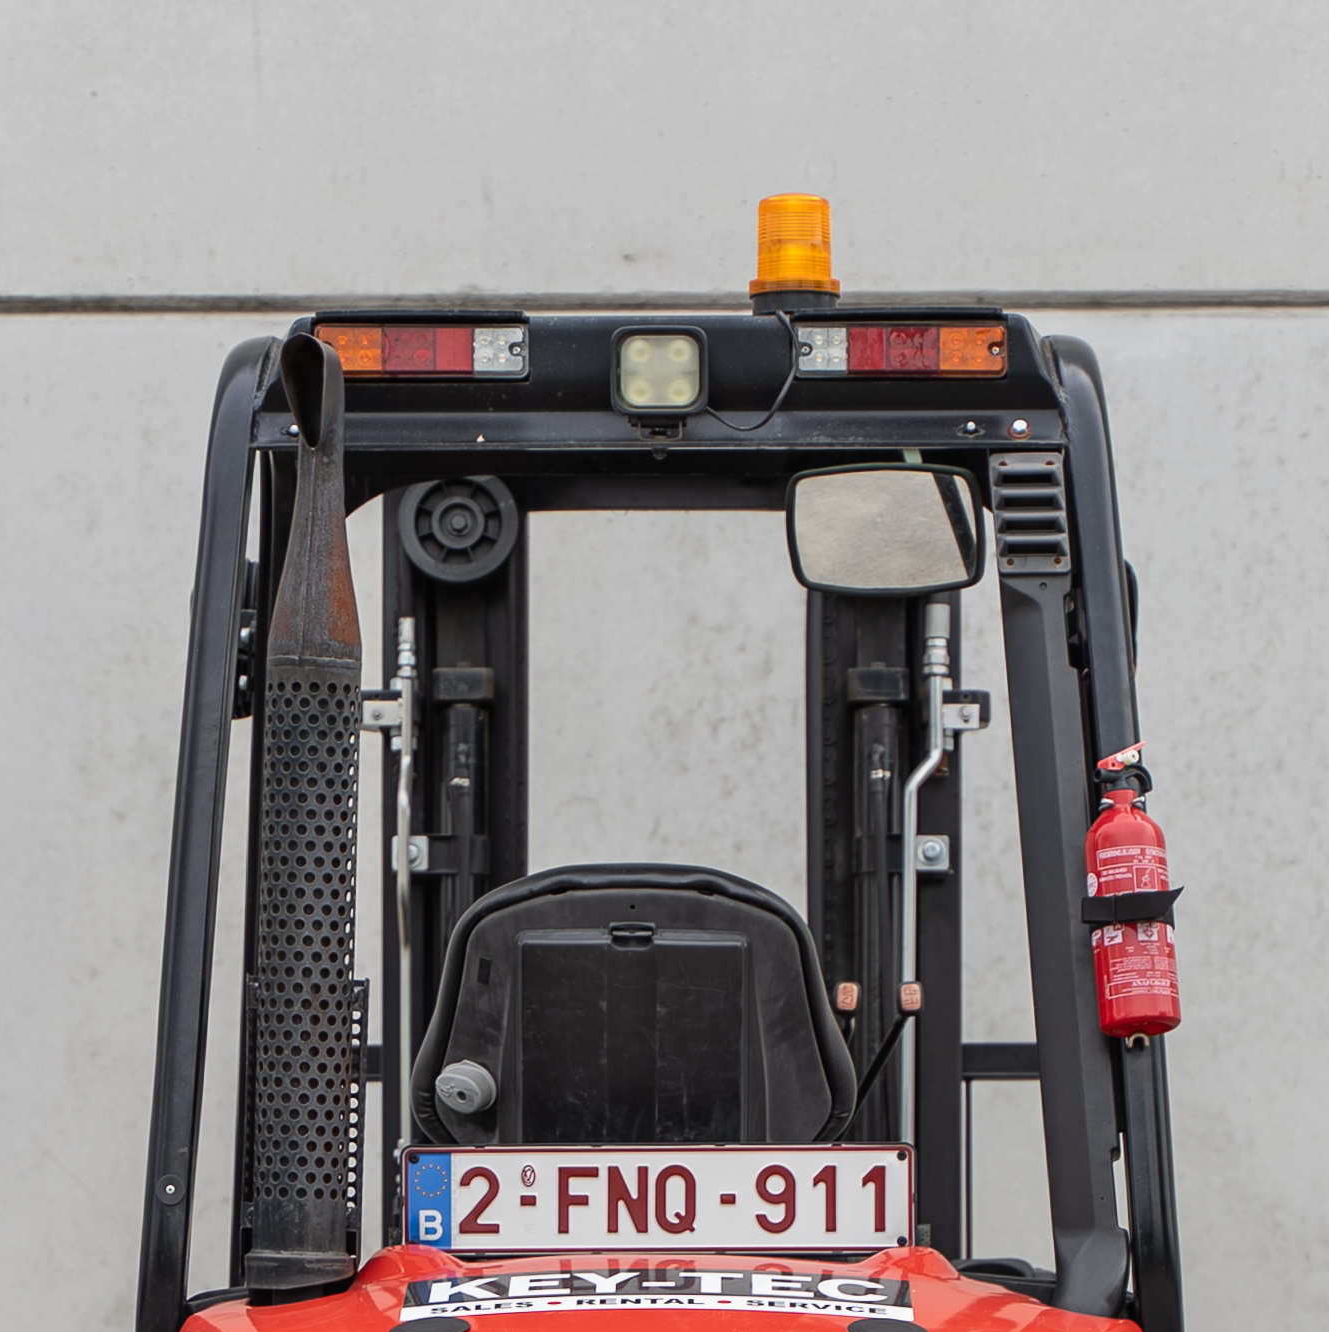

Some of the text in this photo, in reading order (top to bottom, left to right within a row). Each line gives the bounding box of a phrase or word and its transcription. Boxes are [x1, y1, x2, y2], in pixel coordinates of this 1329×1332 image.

[417, 1209, 444, 1242] B
[427, 1271, 890, 1304] KEY-TEC
[430, 1297, 888, 1316] SALES RENTAL SERVICE
